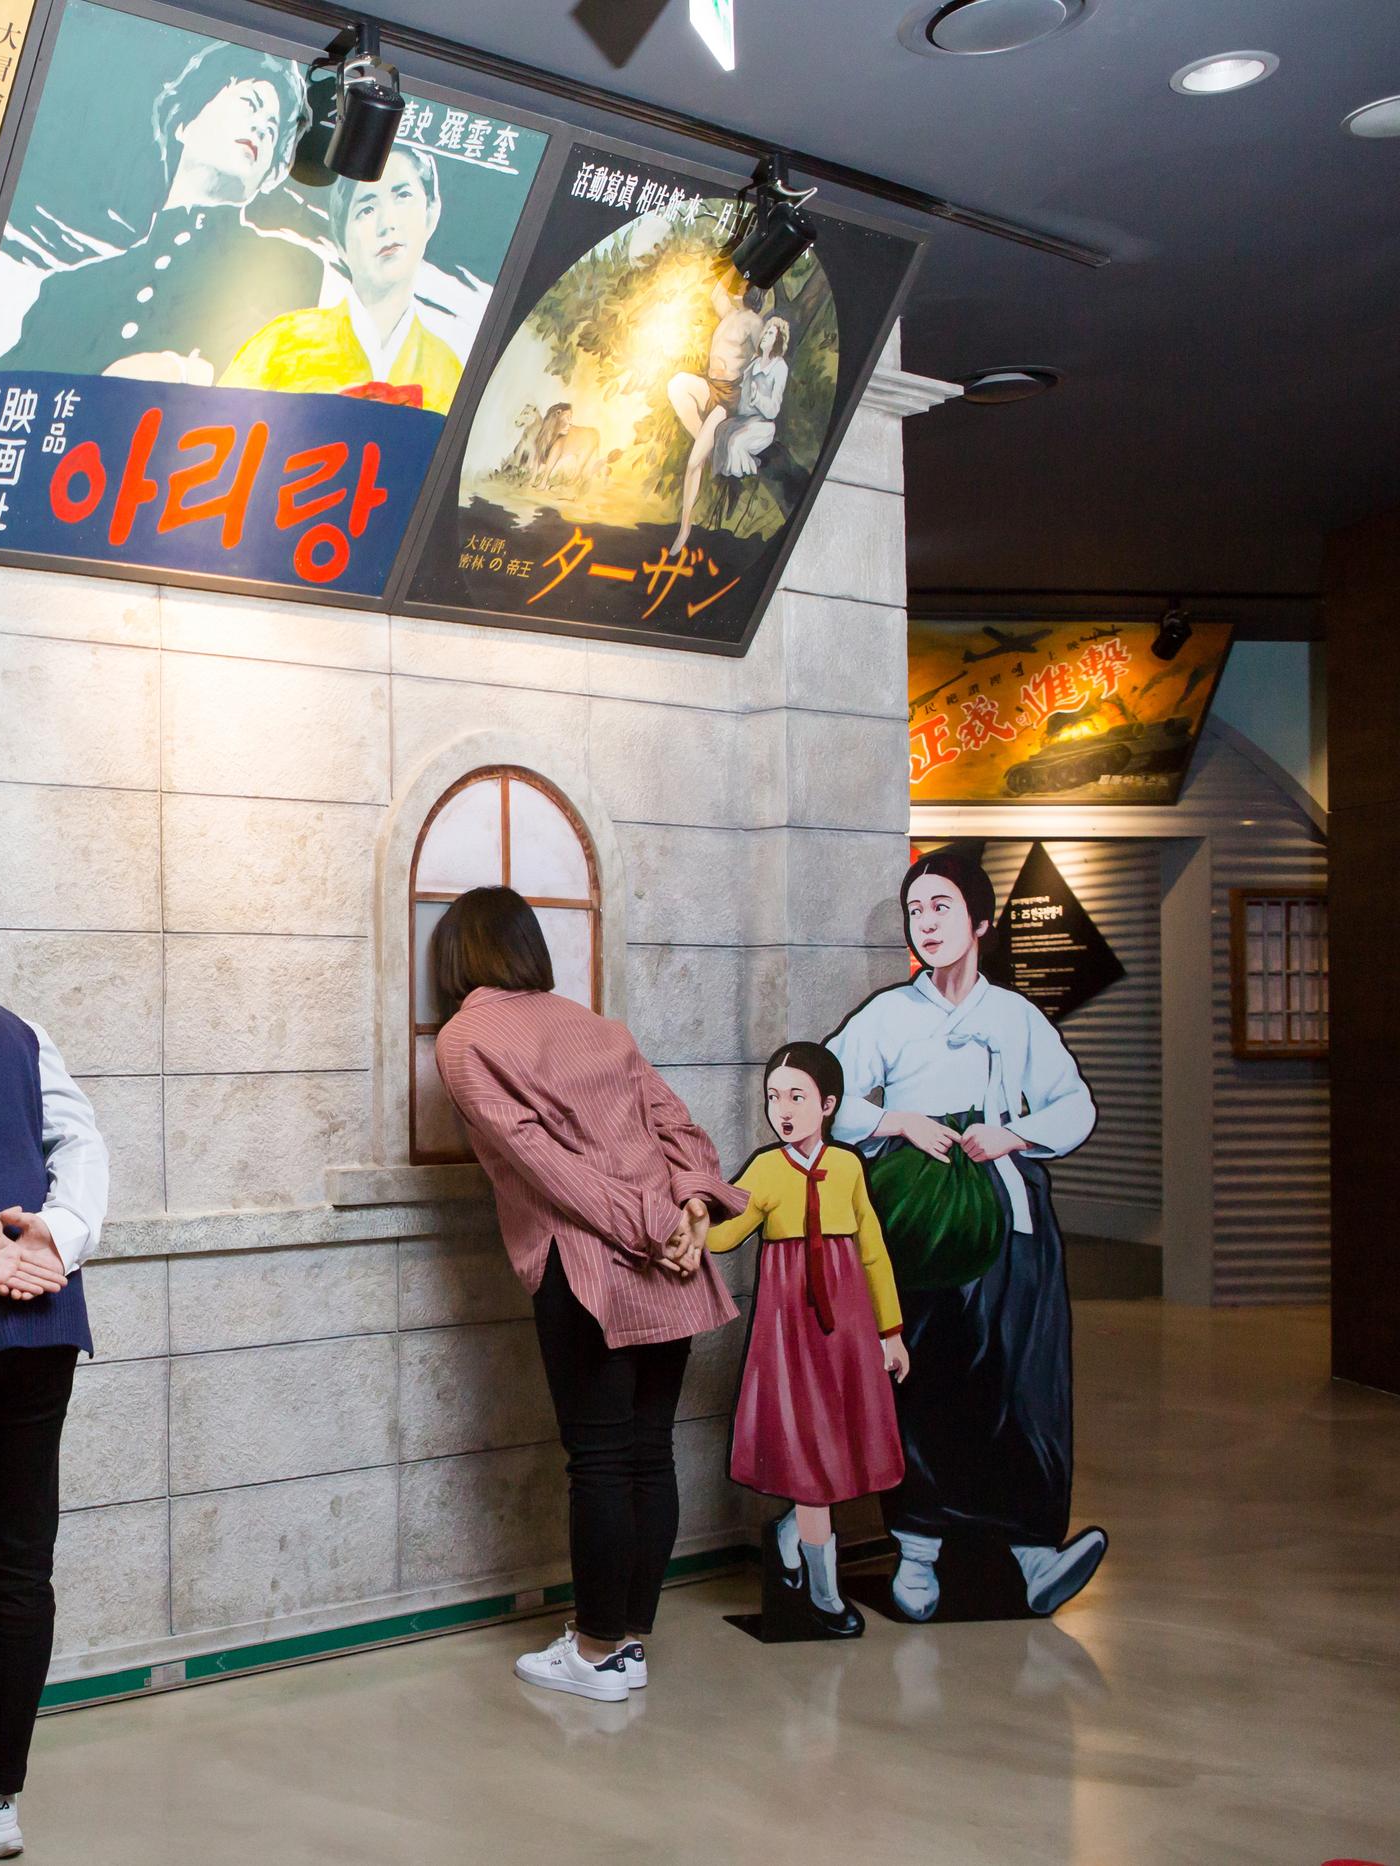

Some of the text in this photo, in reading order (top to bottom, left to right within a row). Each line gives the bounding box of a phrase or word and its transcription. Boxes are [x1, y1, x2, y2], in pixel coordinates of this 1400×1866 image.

[50, 407, 388, 583] 아리랑
[526, 526, 741, 620] ターザン
